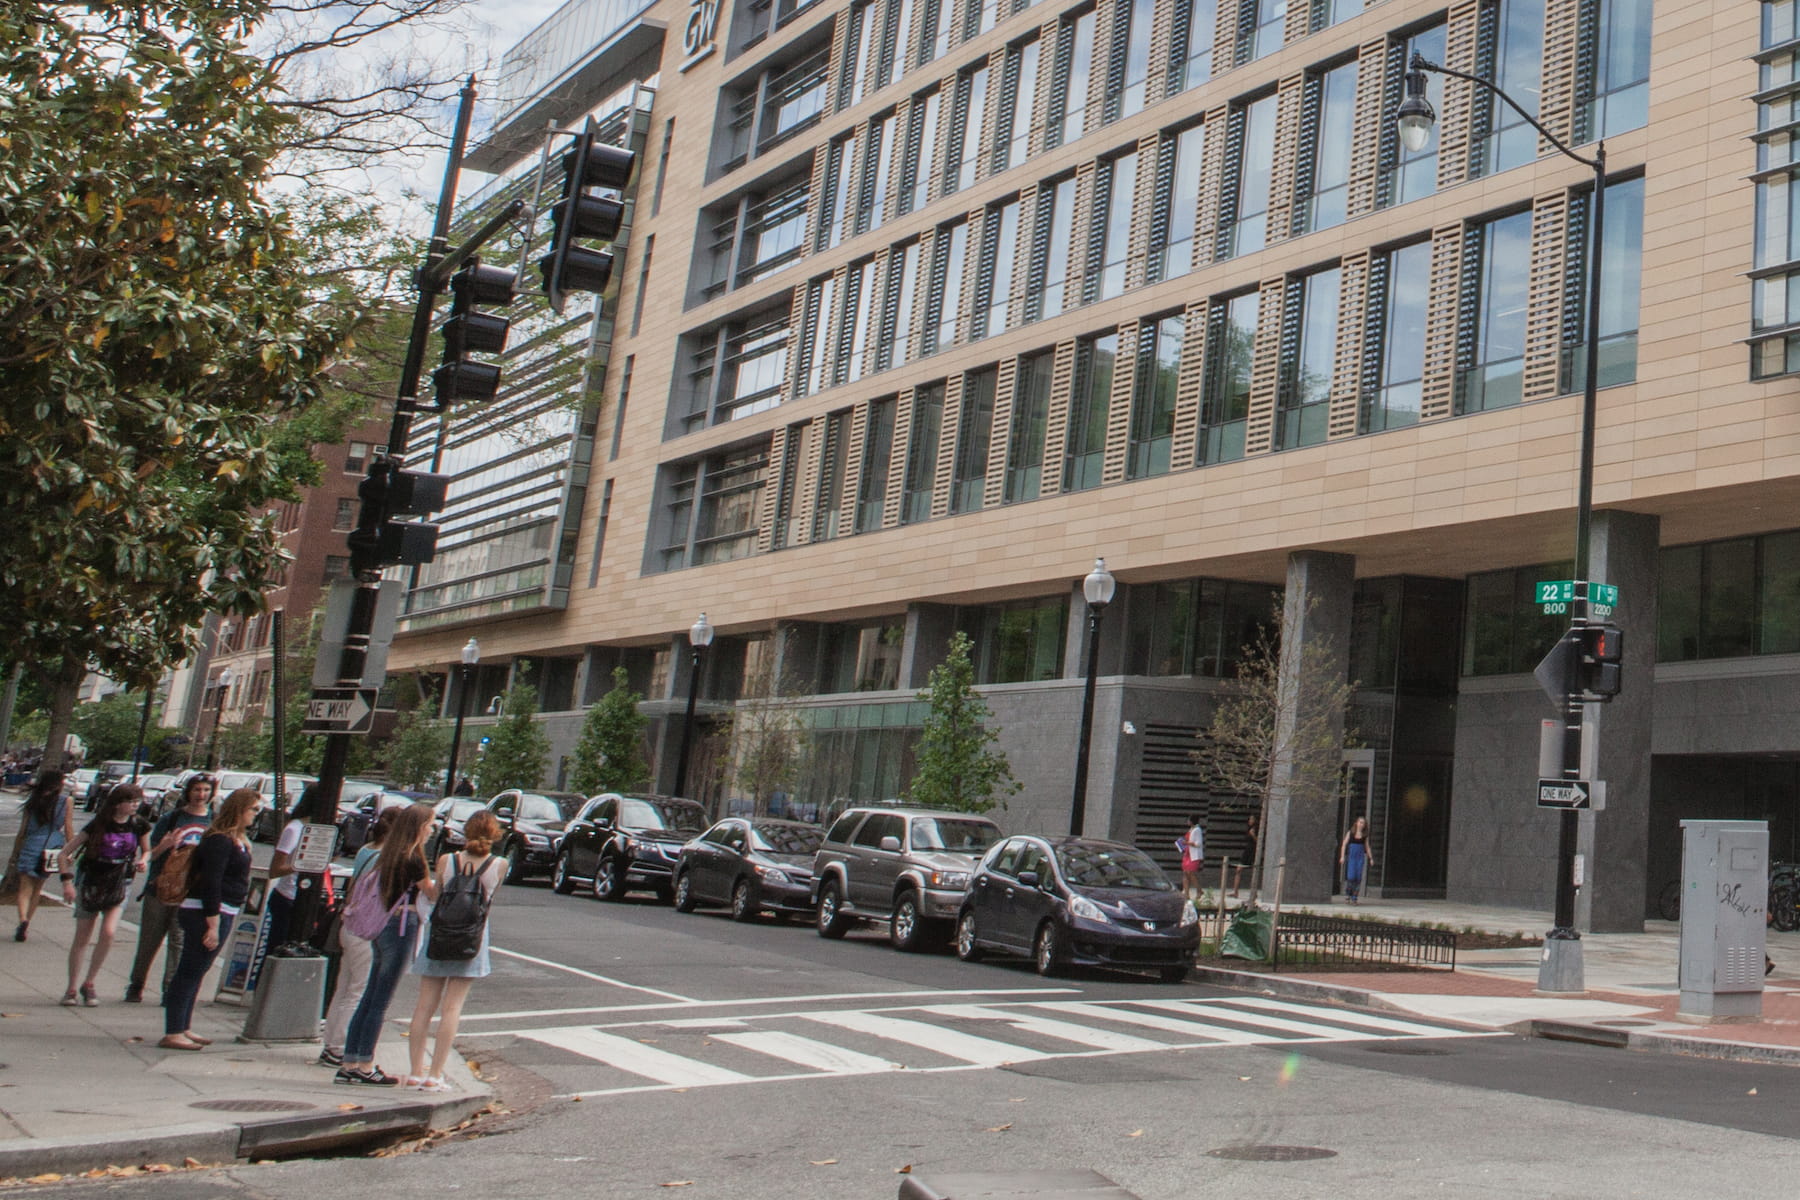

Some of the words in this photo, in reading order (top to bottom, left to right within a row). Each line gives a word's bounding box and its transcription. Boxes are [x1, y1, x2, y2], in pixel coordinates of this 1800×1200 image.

[1542, 585, 1558, 600] 22
[1543, 603, 1566, 614] 800
[1594, 604, 1611, 615] 2200
[328, 701, 352, 718] WAY
[1543, 788, 1555, 799] ONE
[1557, 788, 1572, 799] WAY
